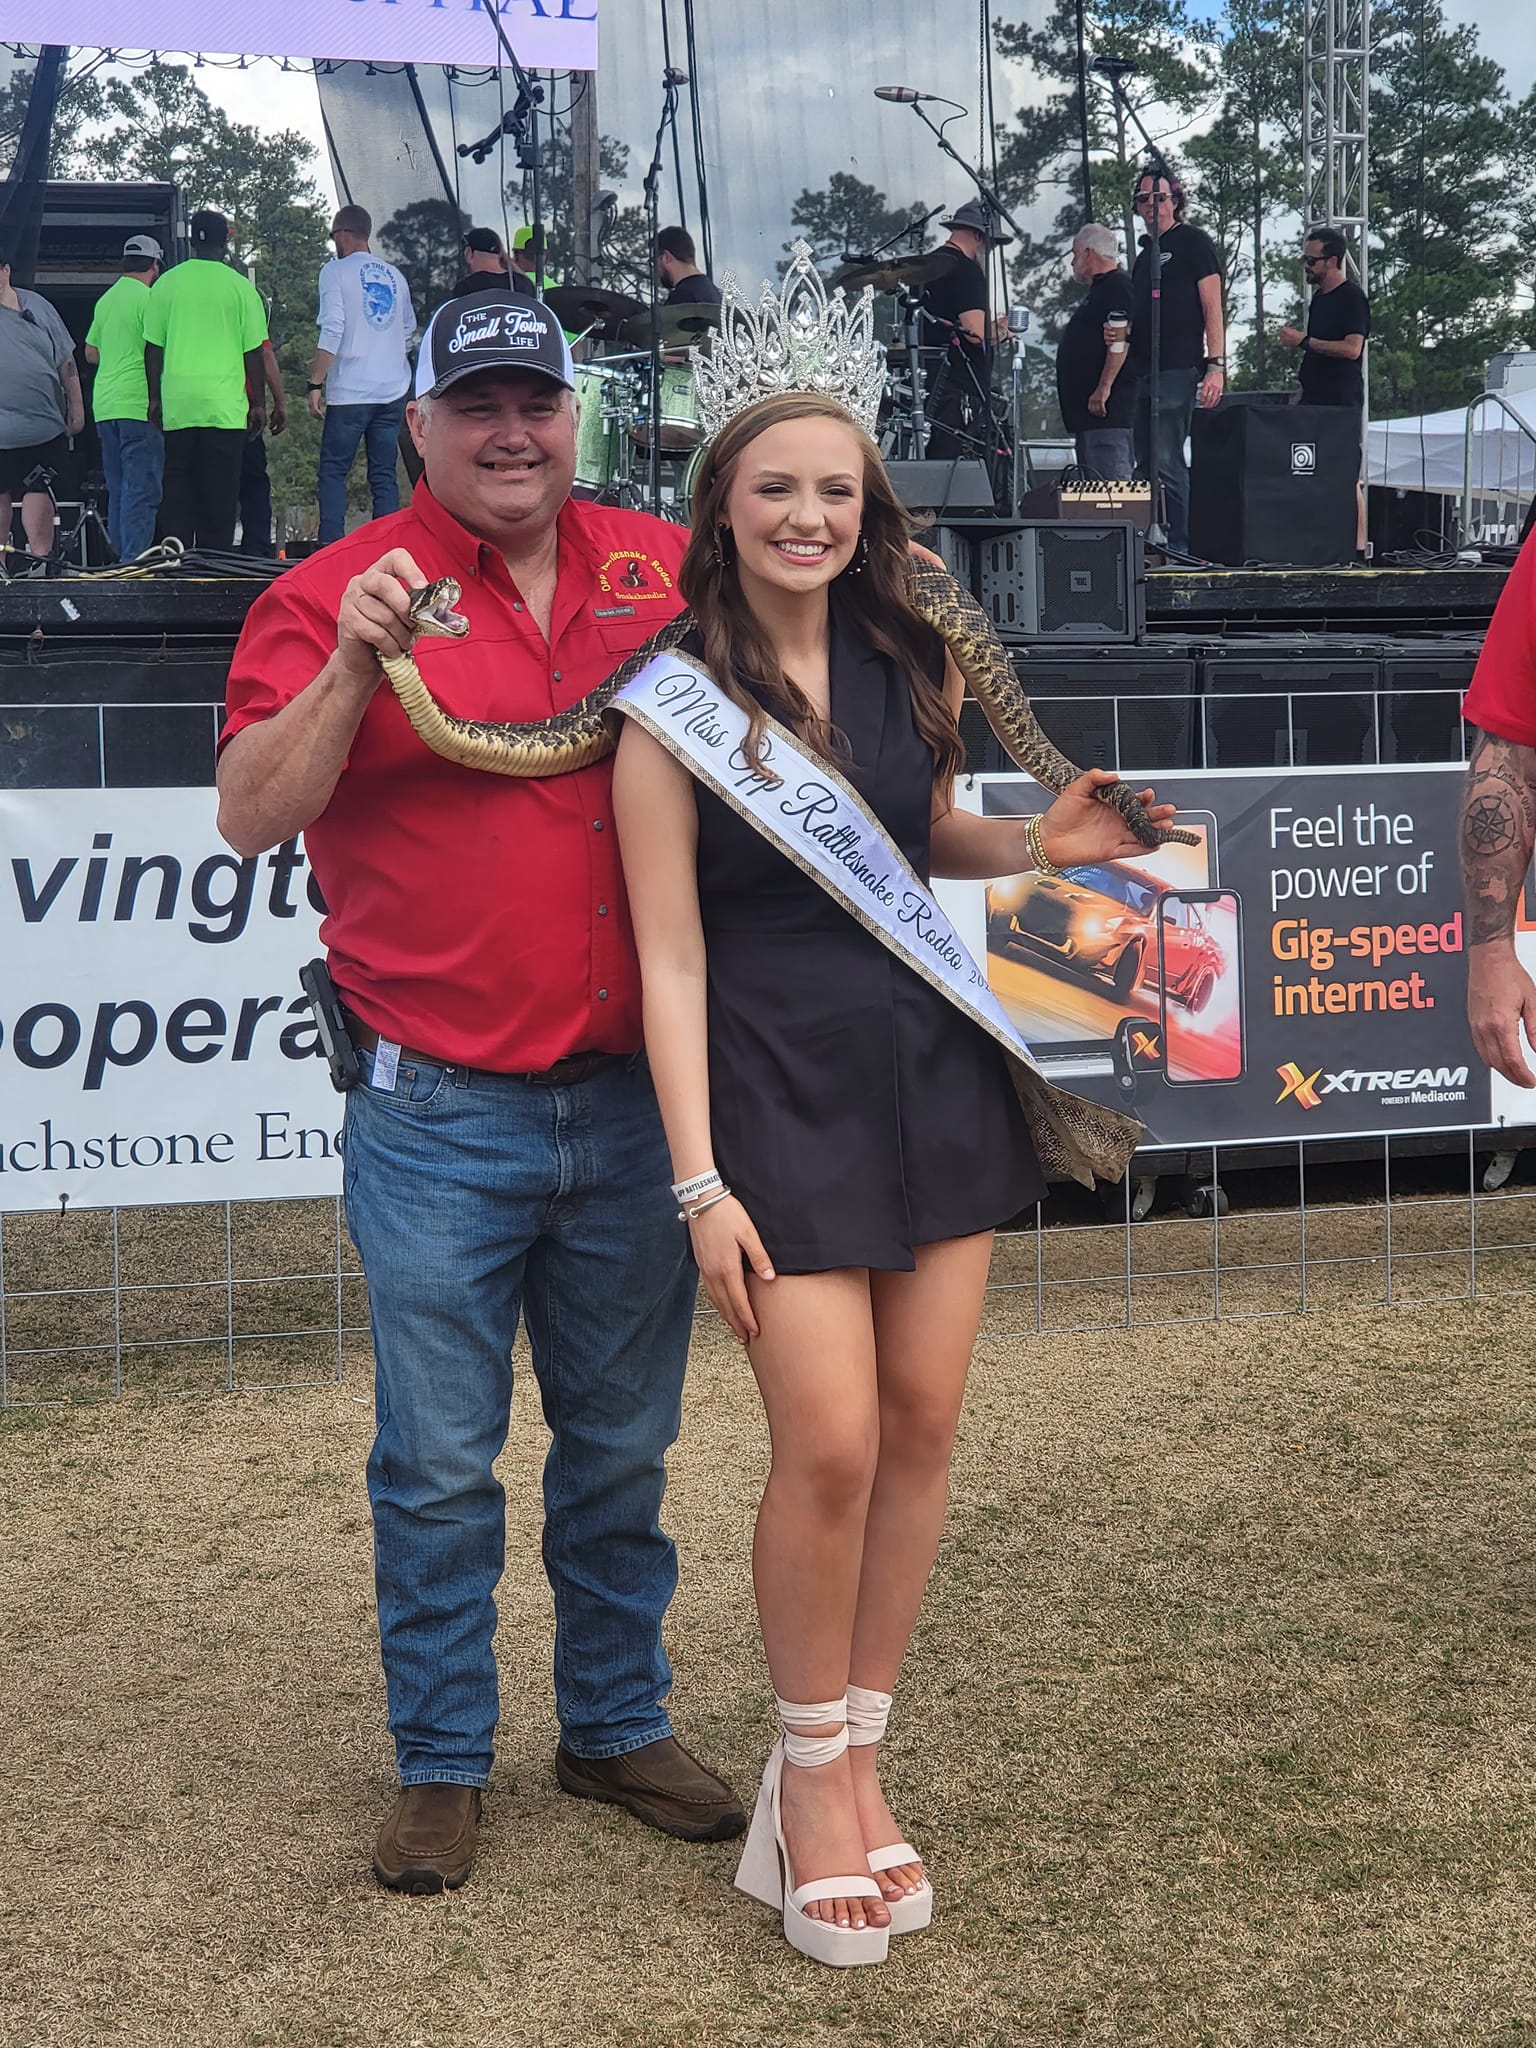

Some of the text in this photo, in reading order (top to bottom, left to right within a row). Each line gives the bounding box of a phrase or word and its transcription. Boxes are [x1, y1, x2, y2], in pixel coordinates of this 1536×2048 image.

[448, 311, 548, 354] Small Town
[465, 312, 488, 323] THE
[509, 336, 535, 347] LIFE
[1469, 523, 1524, 546] VITA
[599, 573, 612, 593] Opp
[651, 559, 674, 589] Rodeo
[654, 673, 730, 748] Miss
[779, 781, 895, 908] Rattlesnake
[896, 890, 964, 971] Rodeo
[967, 969, 995, 996] 202
[1269, 802, 1415, 849] Feel the
[1270, 850, 1435, 913] power of
[1270, 910, 1464, 972] Gig-speed
[1272, 970, 1436, 1017] internet.
[0, 996, 330, 1091] opera
[1319, 1066, 1470, 1095] XTREAM
[1410, 1089, 1466, 1104] Mediacom
[0, 1118, 235, 1173] chstone
